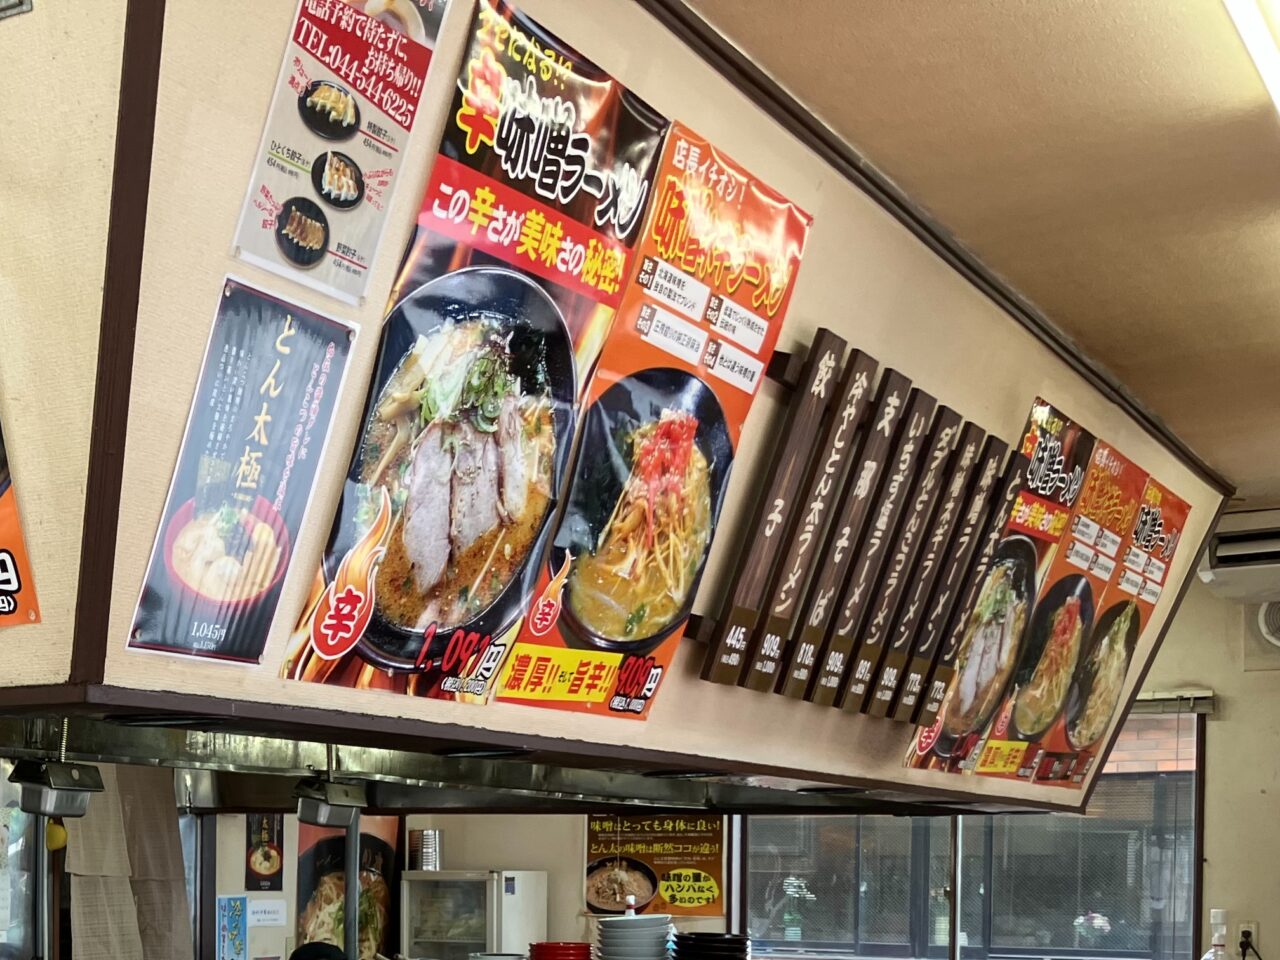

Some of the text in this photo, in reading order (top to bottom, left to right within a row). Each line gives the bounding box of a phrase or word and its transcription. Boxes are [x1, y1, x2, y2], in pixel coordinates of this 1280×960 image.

[297, 17, 414, 127] TEL:044-544-6225
[432, 183, 627, 295] この辛さが美味さの秘密!
[235, 314, 296, 490] とん太極
[775, 371, 867, 613] 冷やしとん太ラーメン
[191, 620, 227, 642] 1,045円
[319, 585, 364, 646] 辛
[534, 600, 556, 627] 辛
[415, 621, 507, 680] 1,091円
[507, 652, 559, 697] 濃厚!!
[570, 660, 617, 696] 旨辛!!
[590, 819, 720, 832] 味噌はとっても身体に良い!
[590, 842, 719, 855] とん太の味噌は断然ココが違う!
